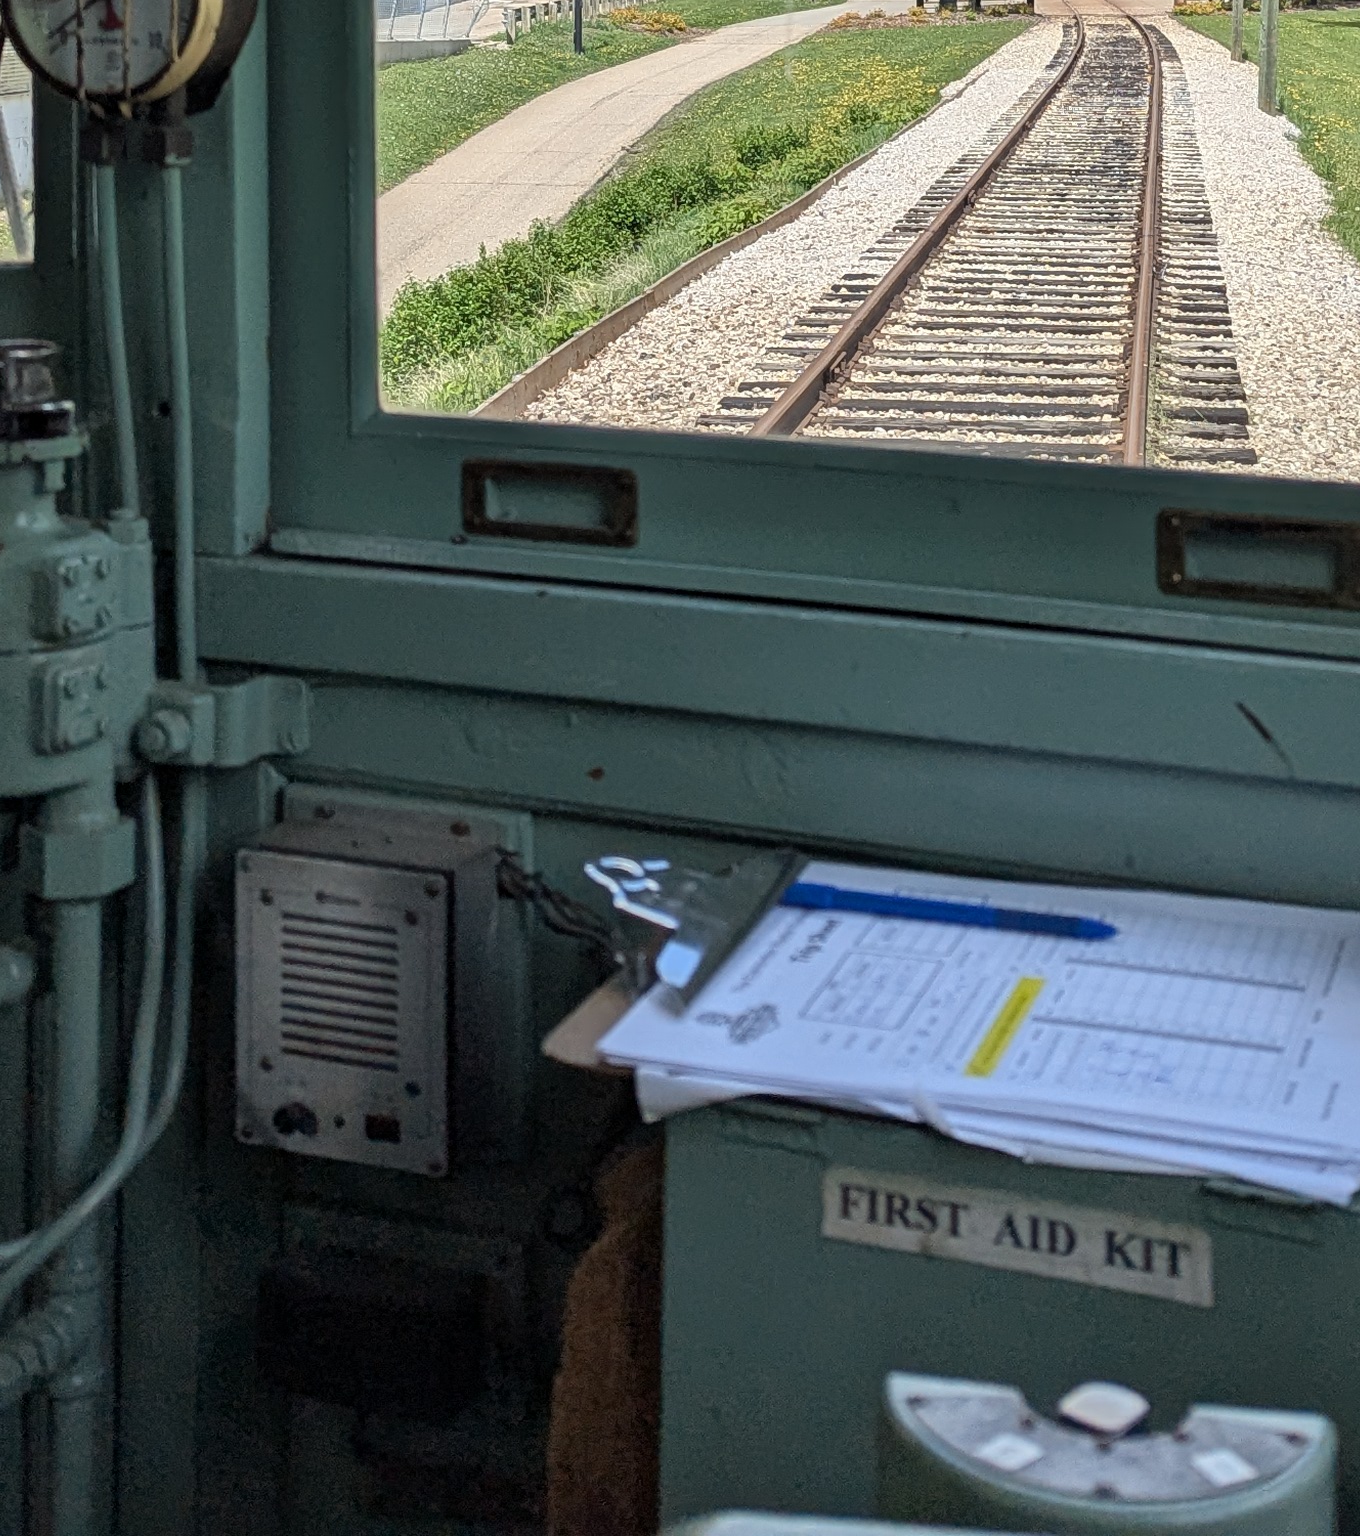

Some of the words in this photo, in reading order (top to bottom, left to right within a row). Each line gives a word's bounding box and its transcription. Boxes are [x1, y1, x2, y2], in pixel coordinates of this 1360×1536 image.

[838, 1181, 969, 1239] FIRST
[993, 1212, 1078, 1258] AID
[1103, 1229, 1192, 1279] KIT
